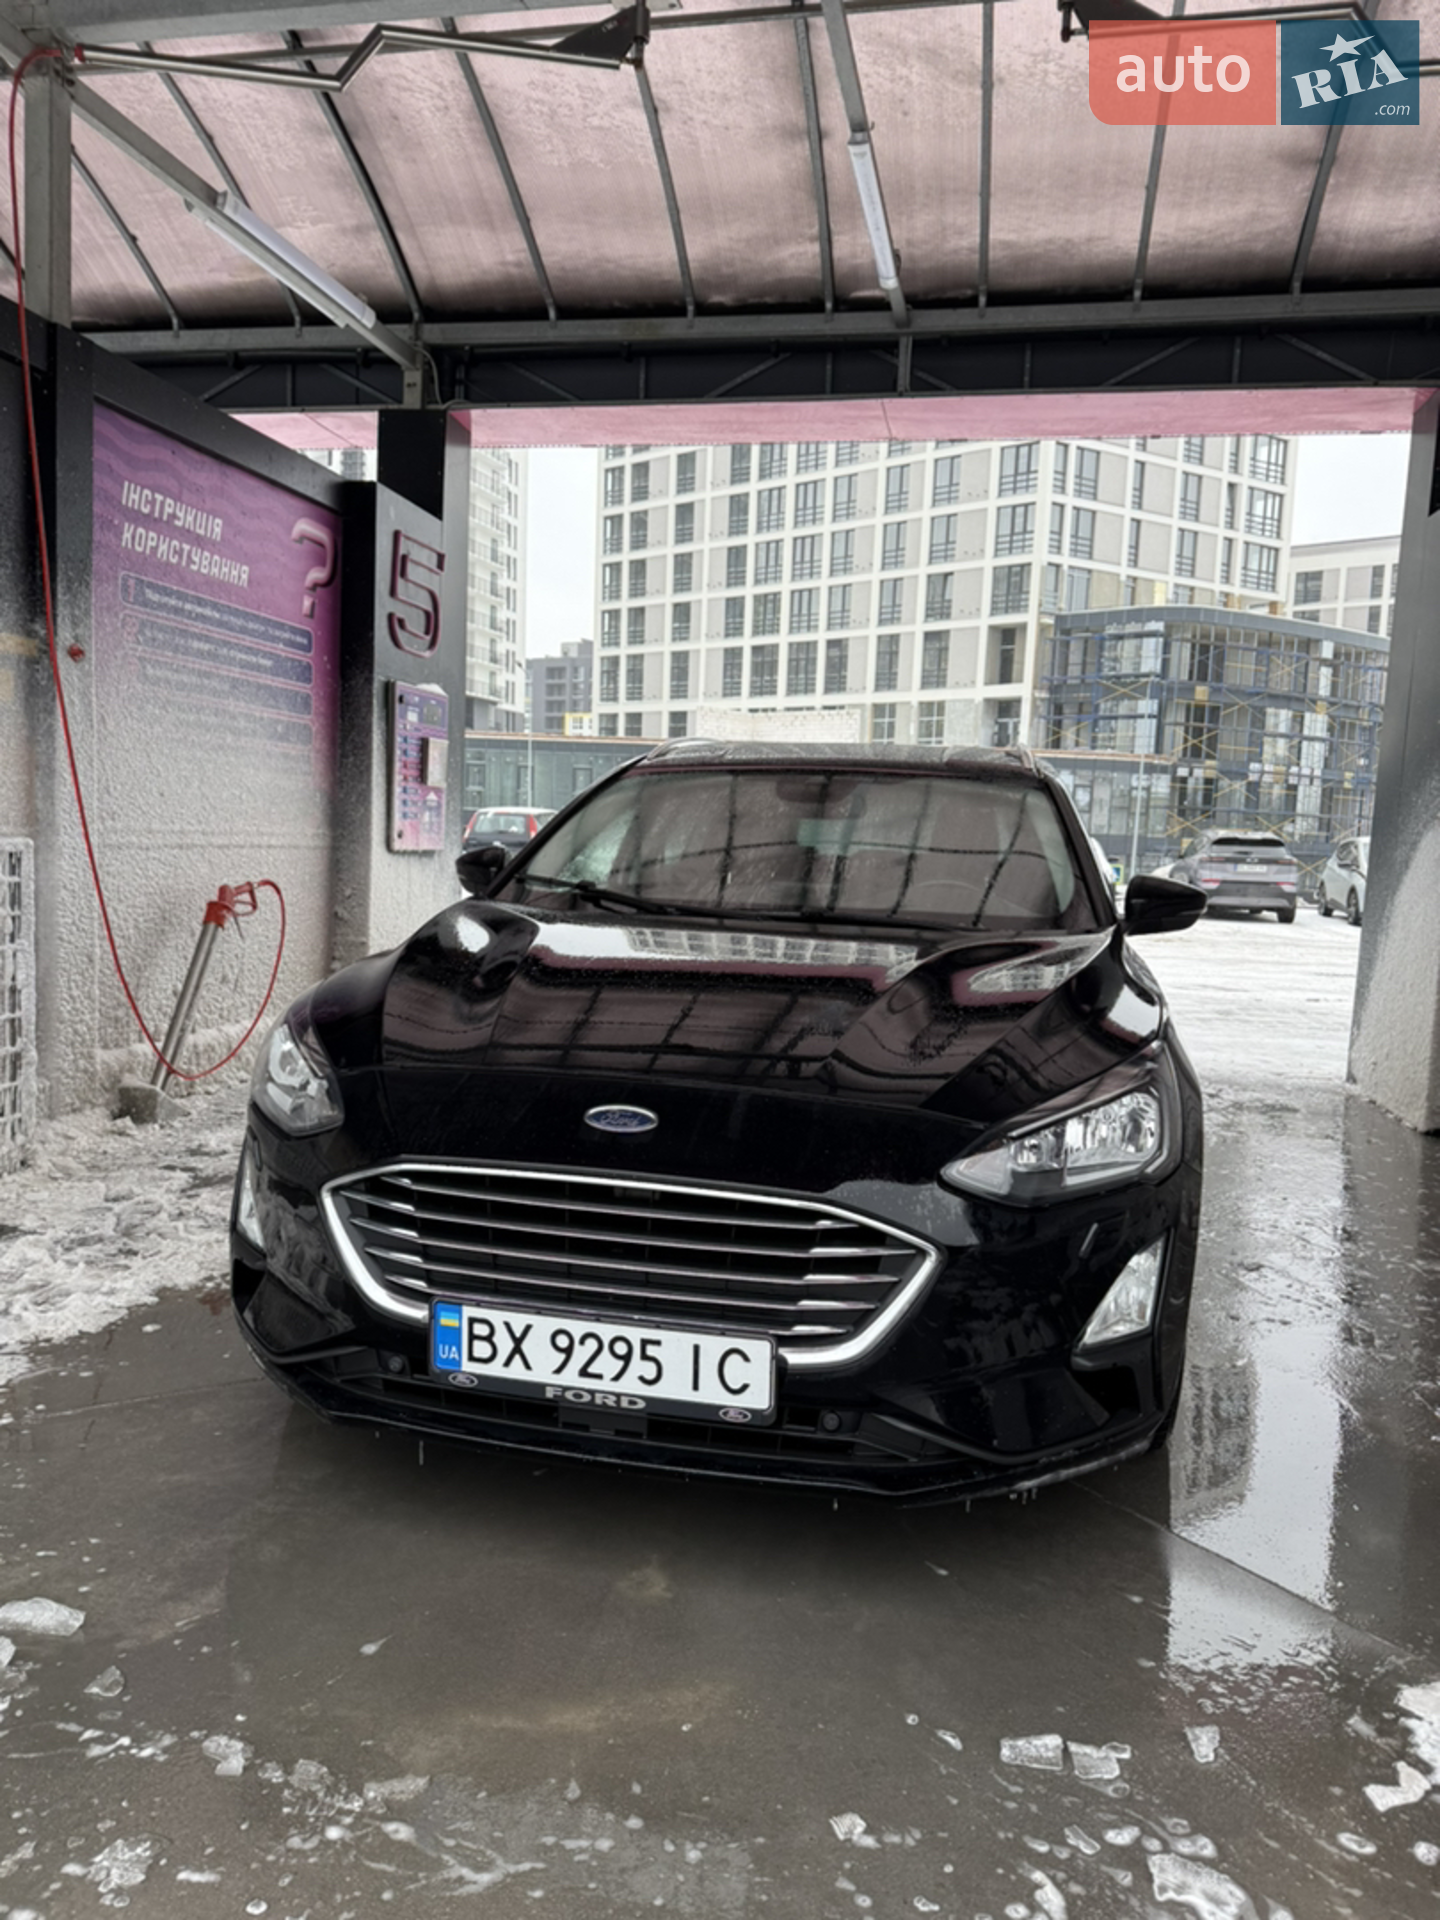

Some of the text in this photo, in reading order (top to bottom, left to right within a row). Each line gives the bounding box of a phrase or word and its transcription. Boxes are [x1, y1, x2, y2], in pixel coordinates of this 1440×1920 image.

[122, 480, 223, 542] ІНСТРУКЦІЯ
[121, 522, 250, 588] КОРИСТУВАННЯ
[387, 530, 446, 659] 5
[438, 1343, 460, 1361] UA
[467, 1316, 751, 1396] BX 9295 IC
[545, 1386, 646, 1409] FORD
